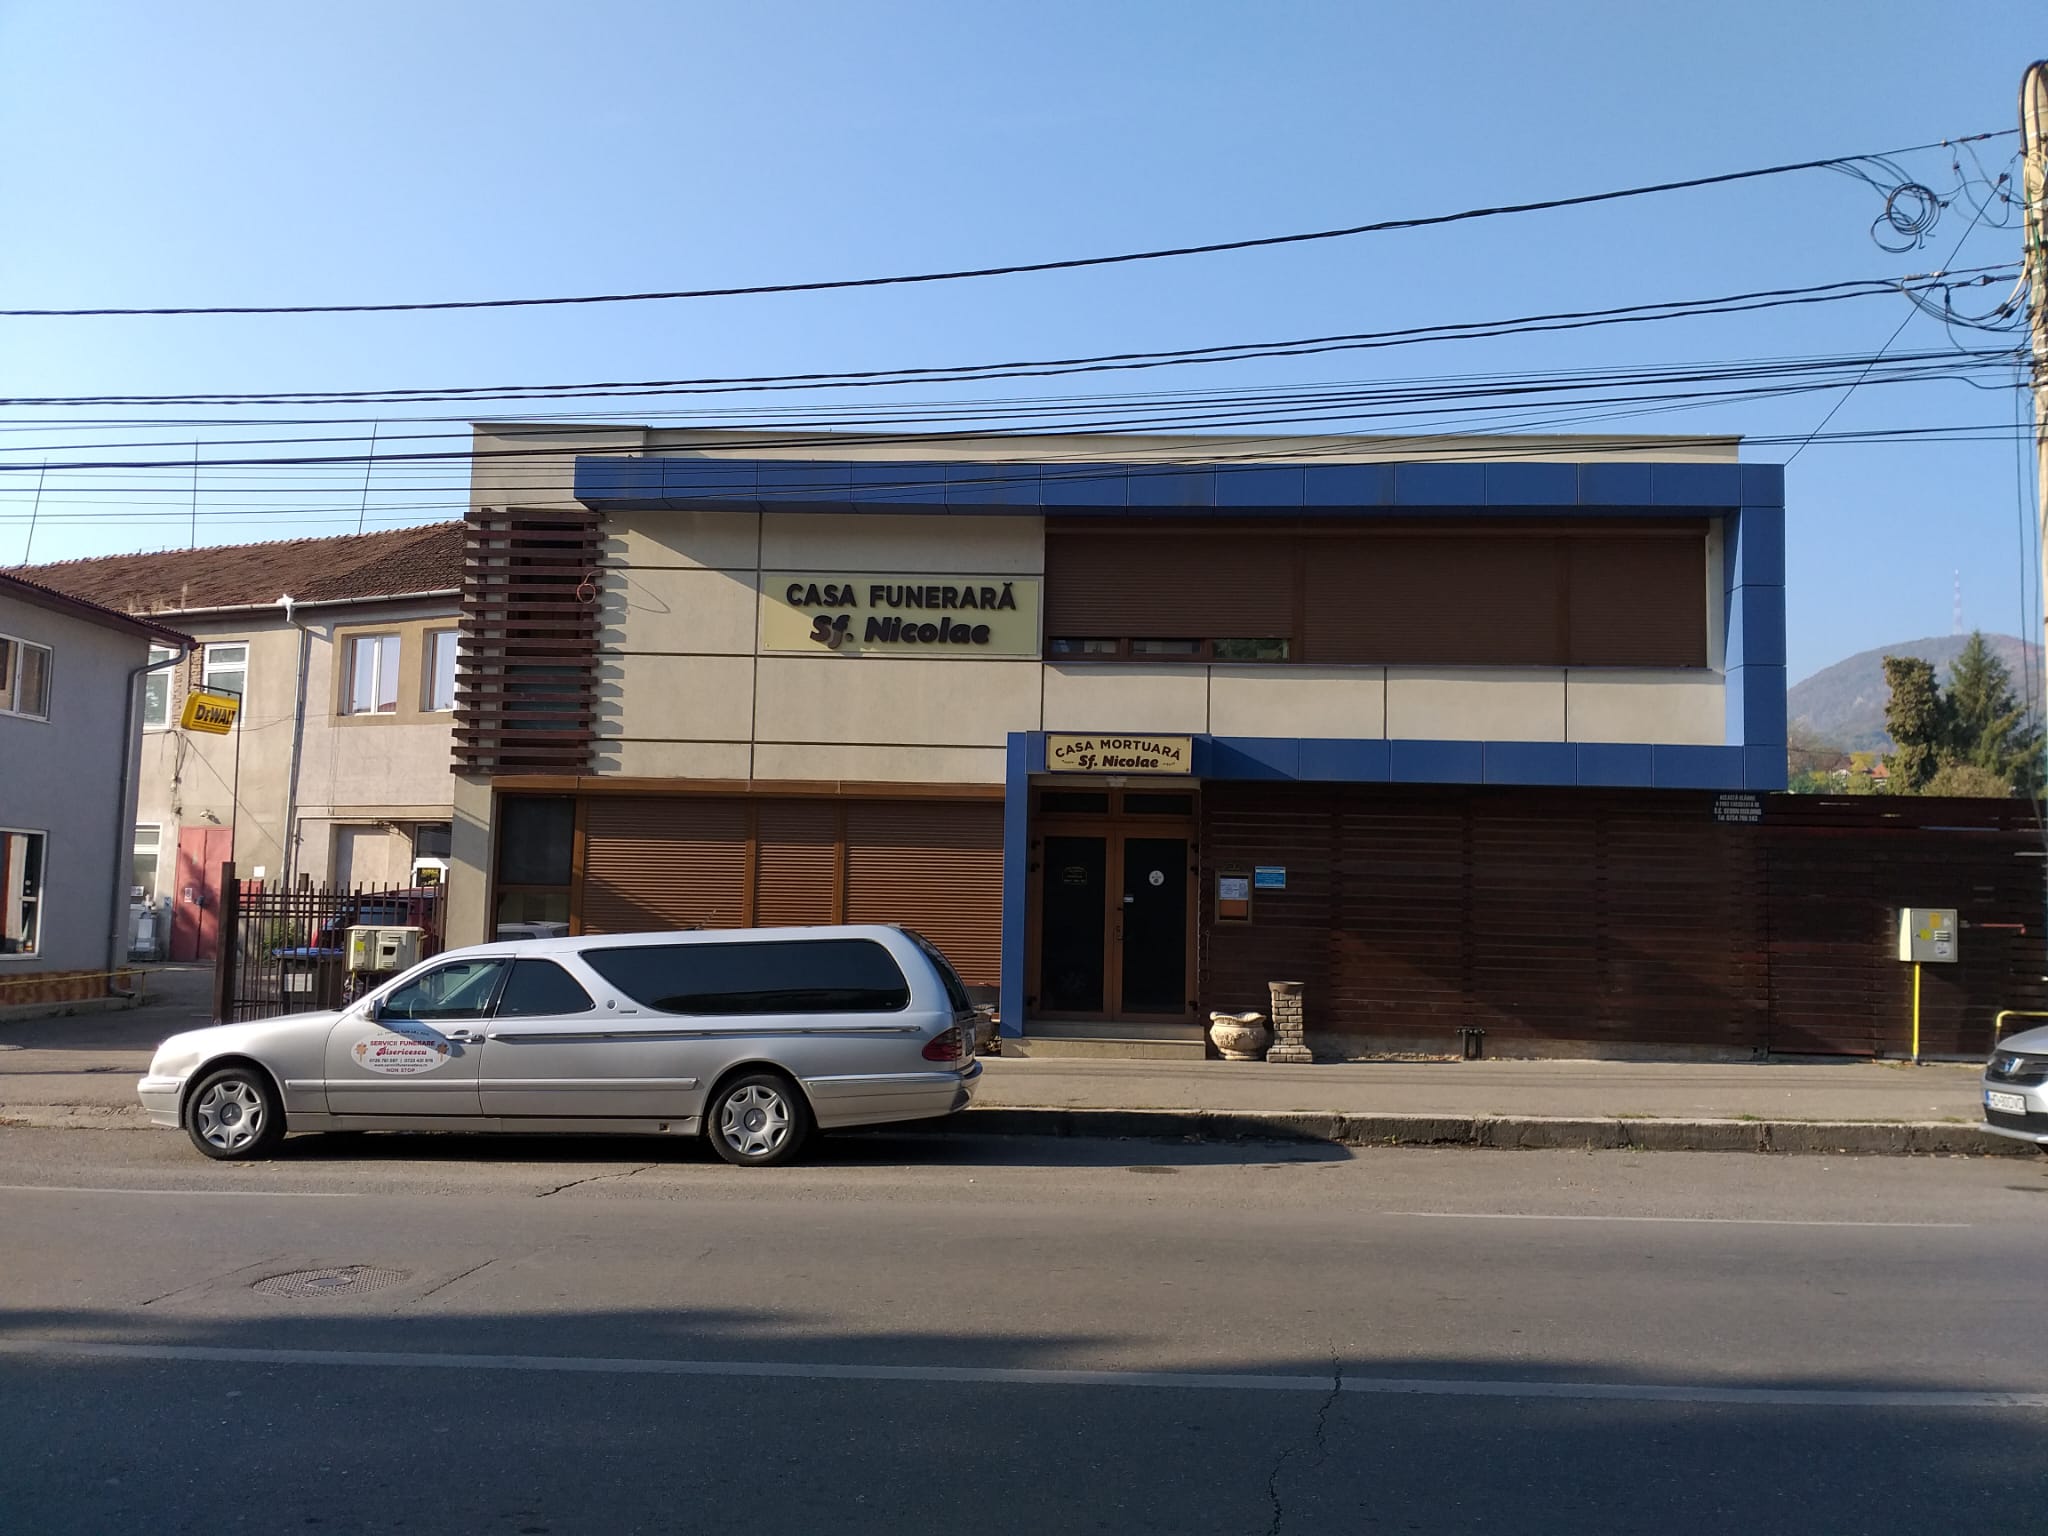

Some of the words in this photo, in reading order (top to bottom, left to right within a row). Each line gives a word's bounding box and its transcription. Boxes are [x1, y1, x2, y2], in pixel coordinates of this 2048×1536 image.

[786, 583, 857, 608] CASA
[869, 582, 1017, 610] FUNERARĂ
[809, 614, 854, 650] Sf.
[864, 616, 990, 645] Nicolae
[1055, 740, 1095, 758] CASA
[1100, 739, 1181, 761] MORTUARĂ
[1078, 754, 1098, 770] Sf.
[1101, 755, 1159, 768] Nicolae
